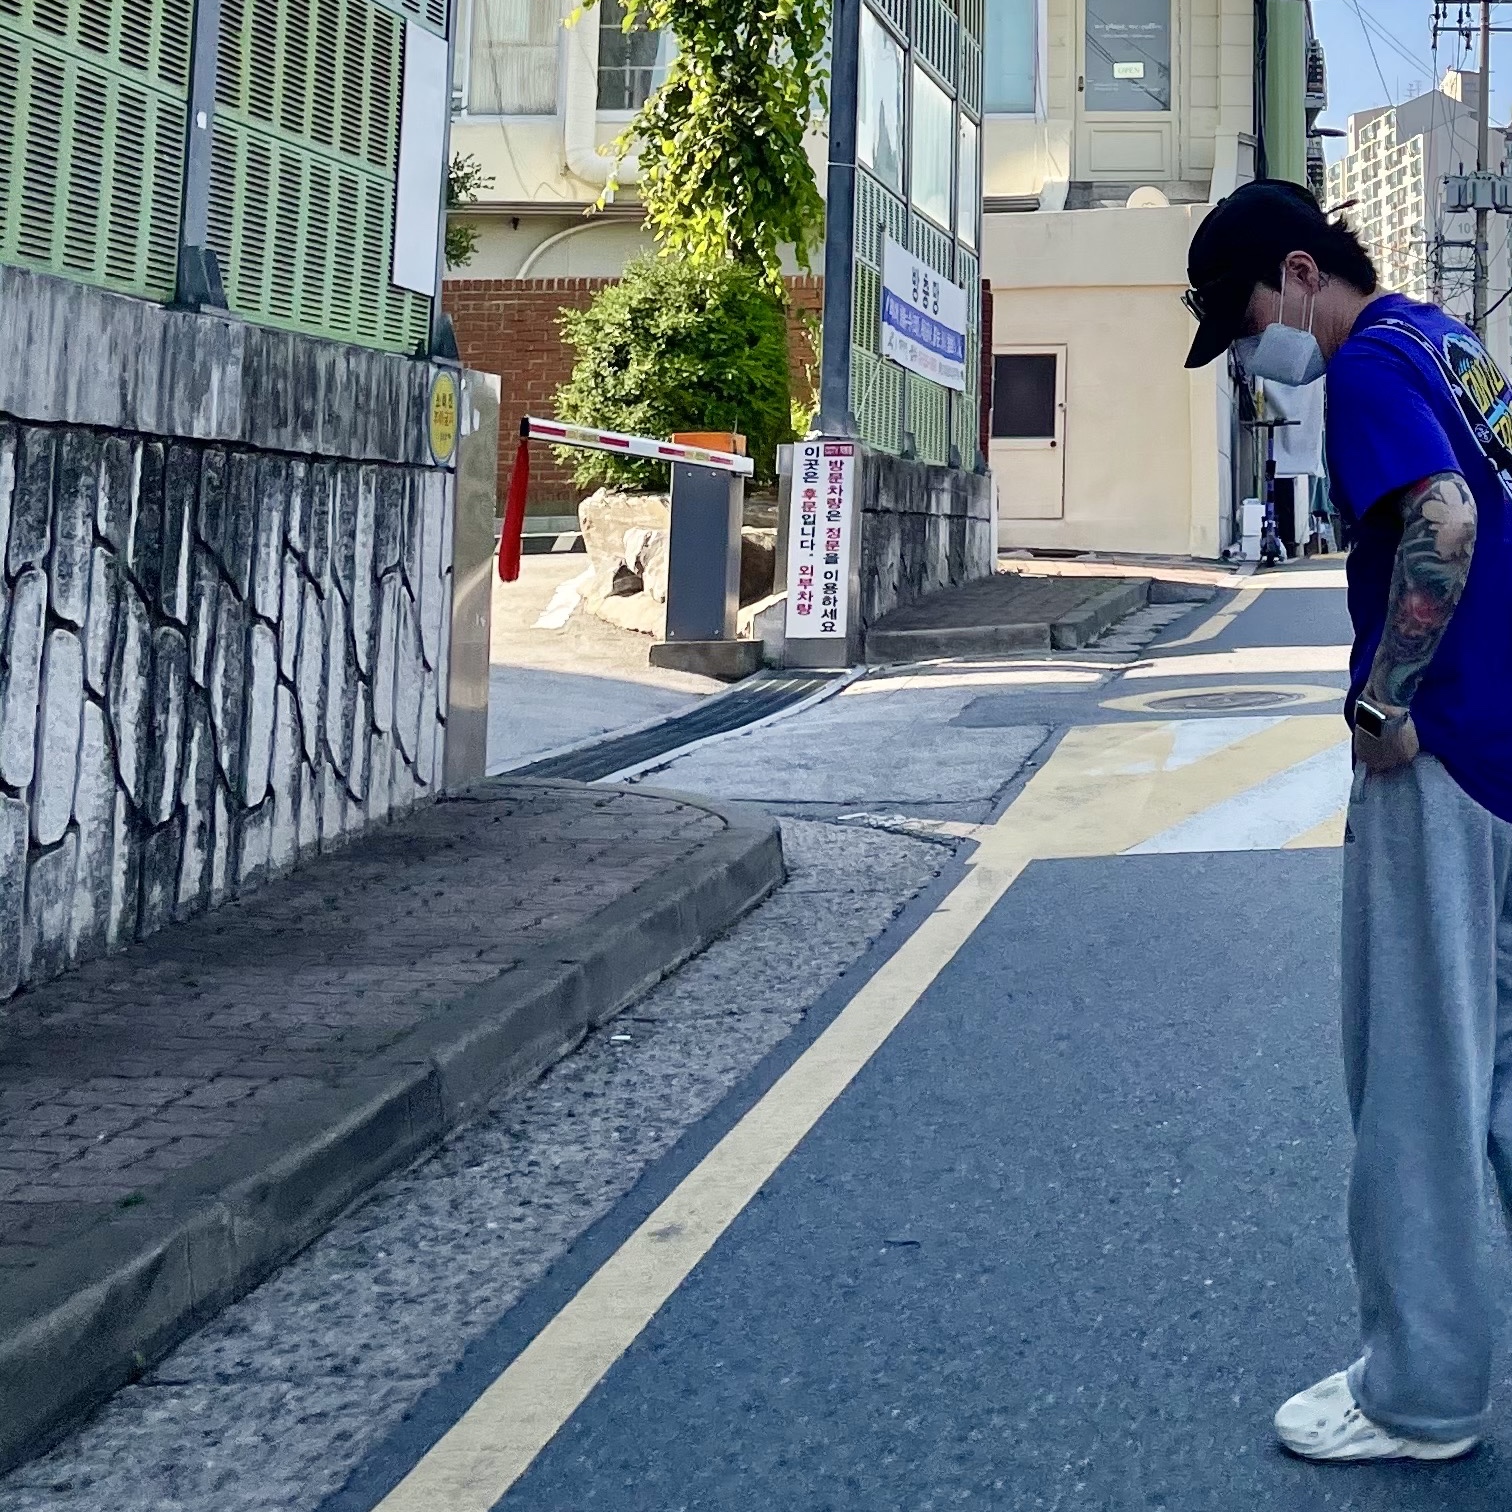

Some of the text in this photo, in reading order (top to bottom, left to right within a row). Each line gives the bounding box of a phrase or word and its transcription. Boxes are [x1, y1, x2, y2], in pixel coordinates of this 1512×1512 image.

[803, 446, 820, 483] 이곳은
[826, 459, 845, 522] 방문차량은
[823, 527, 842, 565] 정문을
[796, 565, 815, 616] 외부차량
[820, 569, 839, 632] 이용하세요
